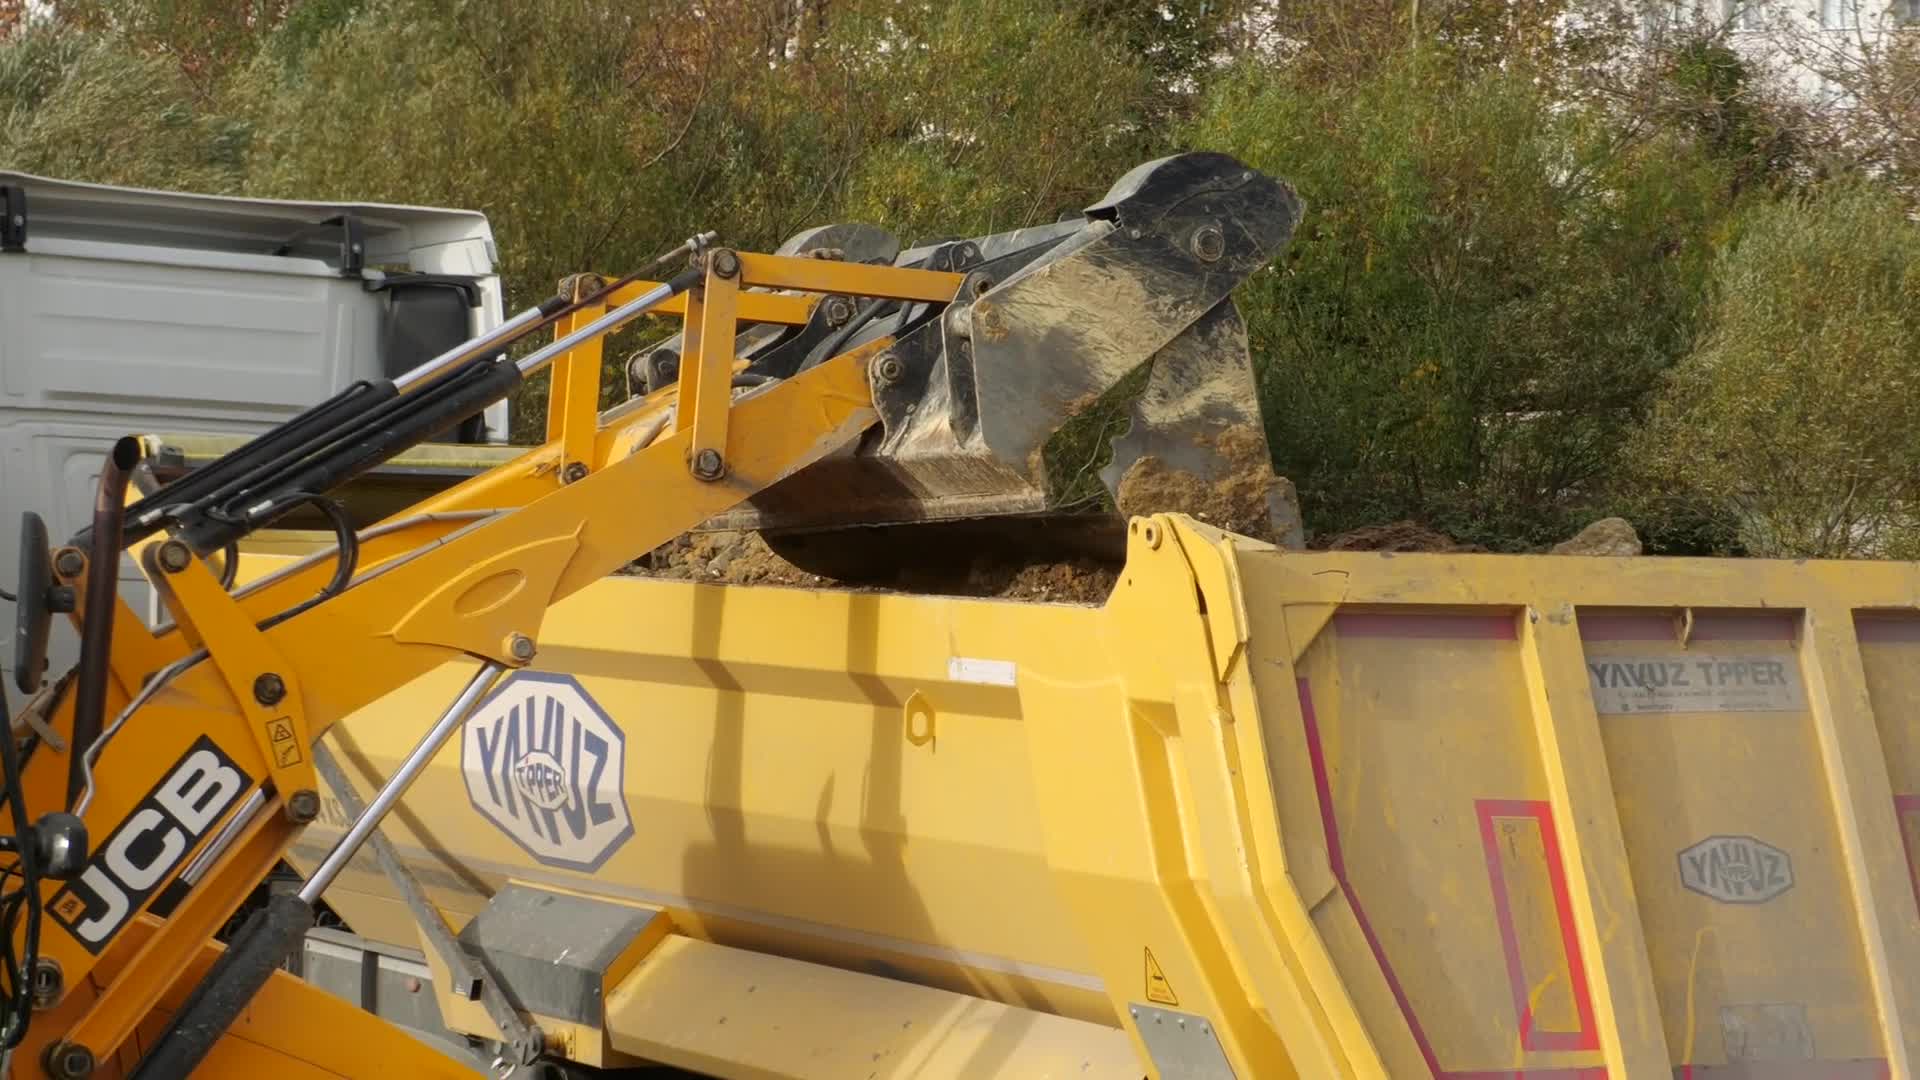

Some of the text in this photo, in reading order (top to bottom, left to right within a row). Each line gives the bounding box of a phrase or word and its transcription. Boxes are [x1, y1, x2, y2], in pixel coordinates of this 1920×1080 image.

[1589, 662, 1689, 688] YAVUZ
[477, 695, 616, 846] YAVUZ
[77, 750, 241, 942] JCB
[1688, 841, 1785, 896] YAVUZ
